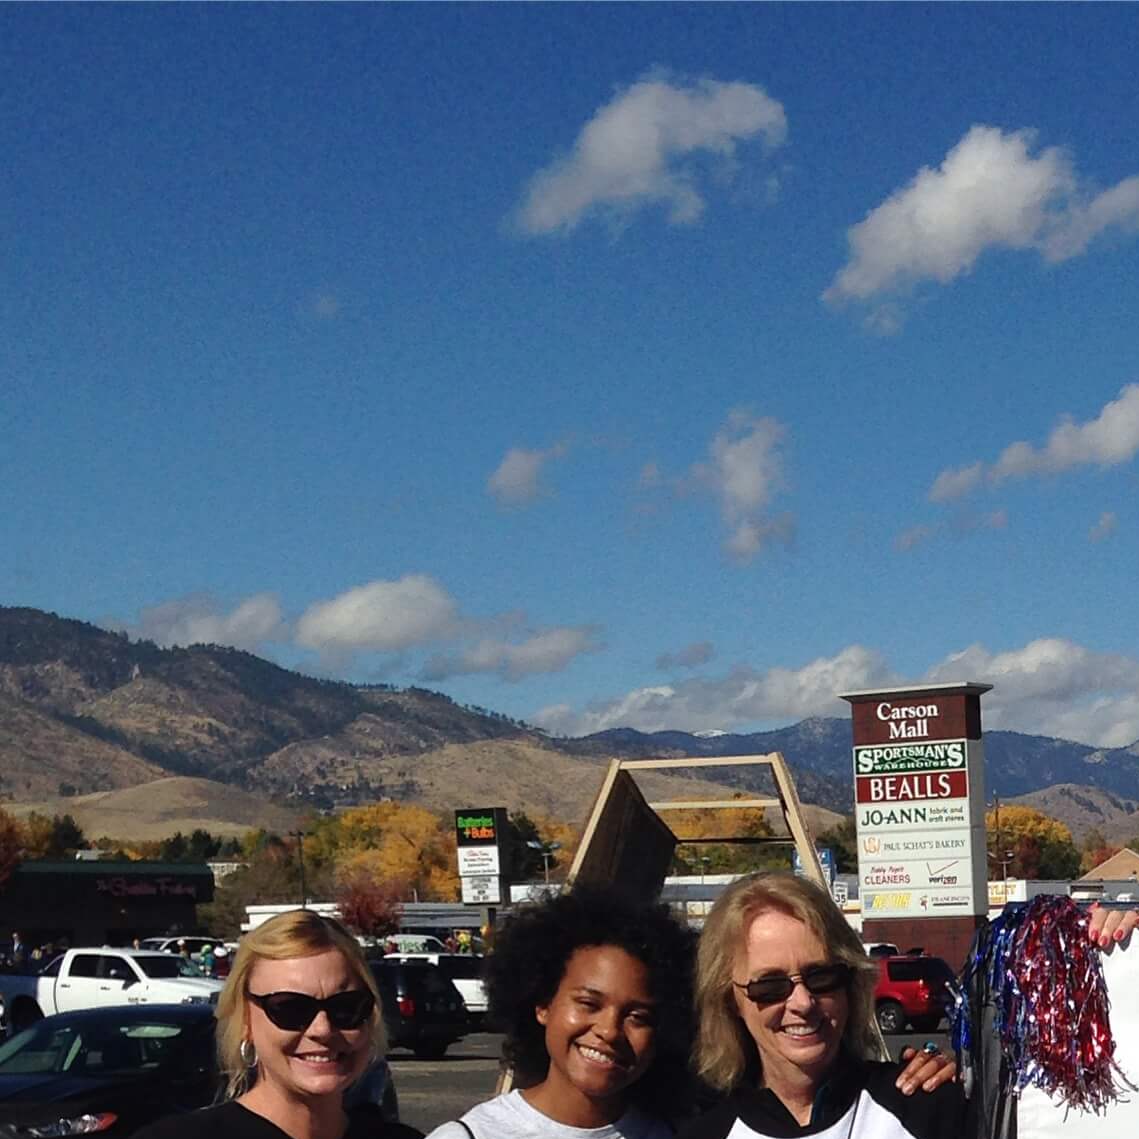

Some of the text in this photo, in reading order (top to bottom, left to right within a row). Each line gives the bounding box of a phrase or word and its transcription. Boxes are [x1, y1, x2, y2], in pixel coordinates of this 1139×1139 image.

[876, 702, 939, 721] Carson
[888, 719, 929, 739] Mall
[858, 744, 963, 773] SPORTSMAN'S
[874, 760, 948, 771] WAREHOUSE
[870, 773, 951, 801] BEALLS
[935, 839, 966, 850] BAKERY
[864, 874, 911, 885] CLEANERS
[928, 874, 958, 885] verizon
